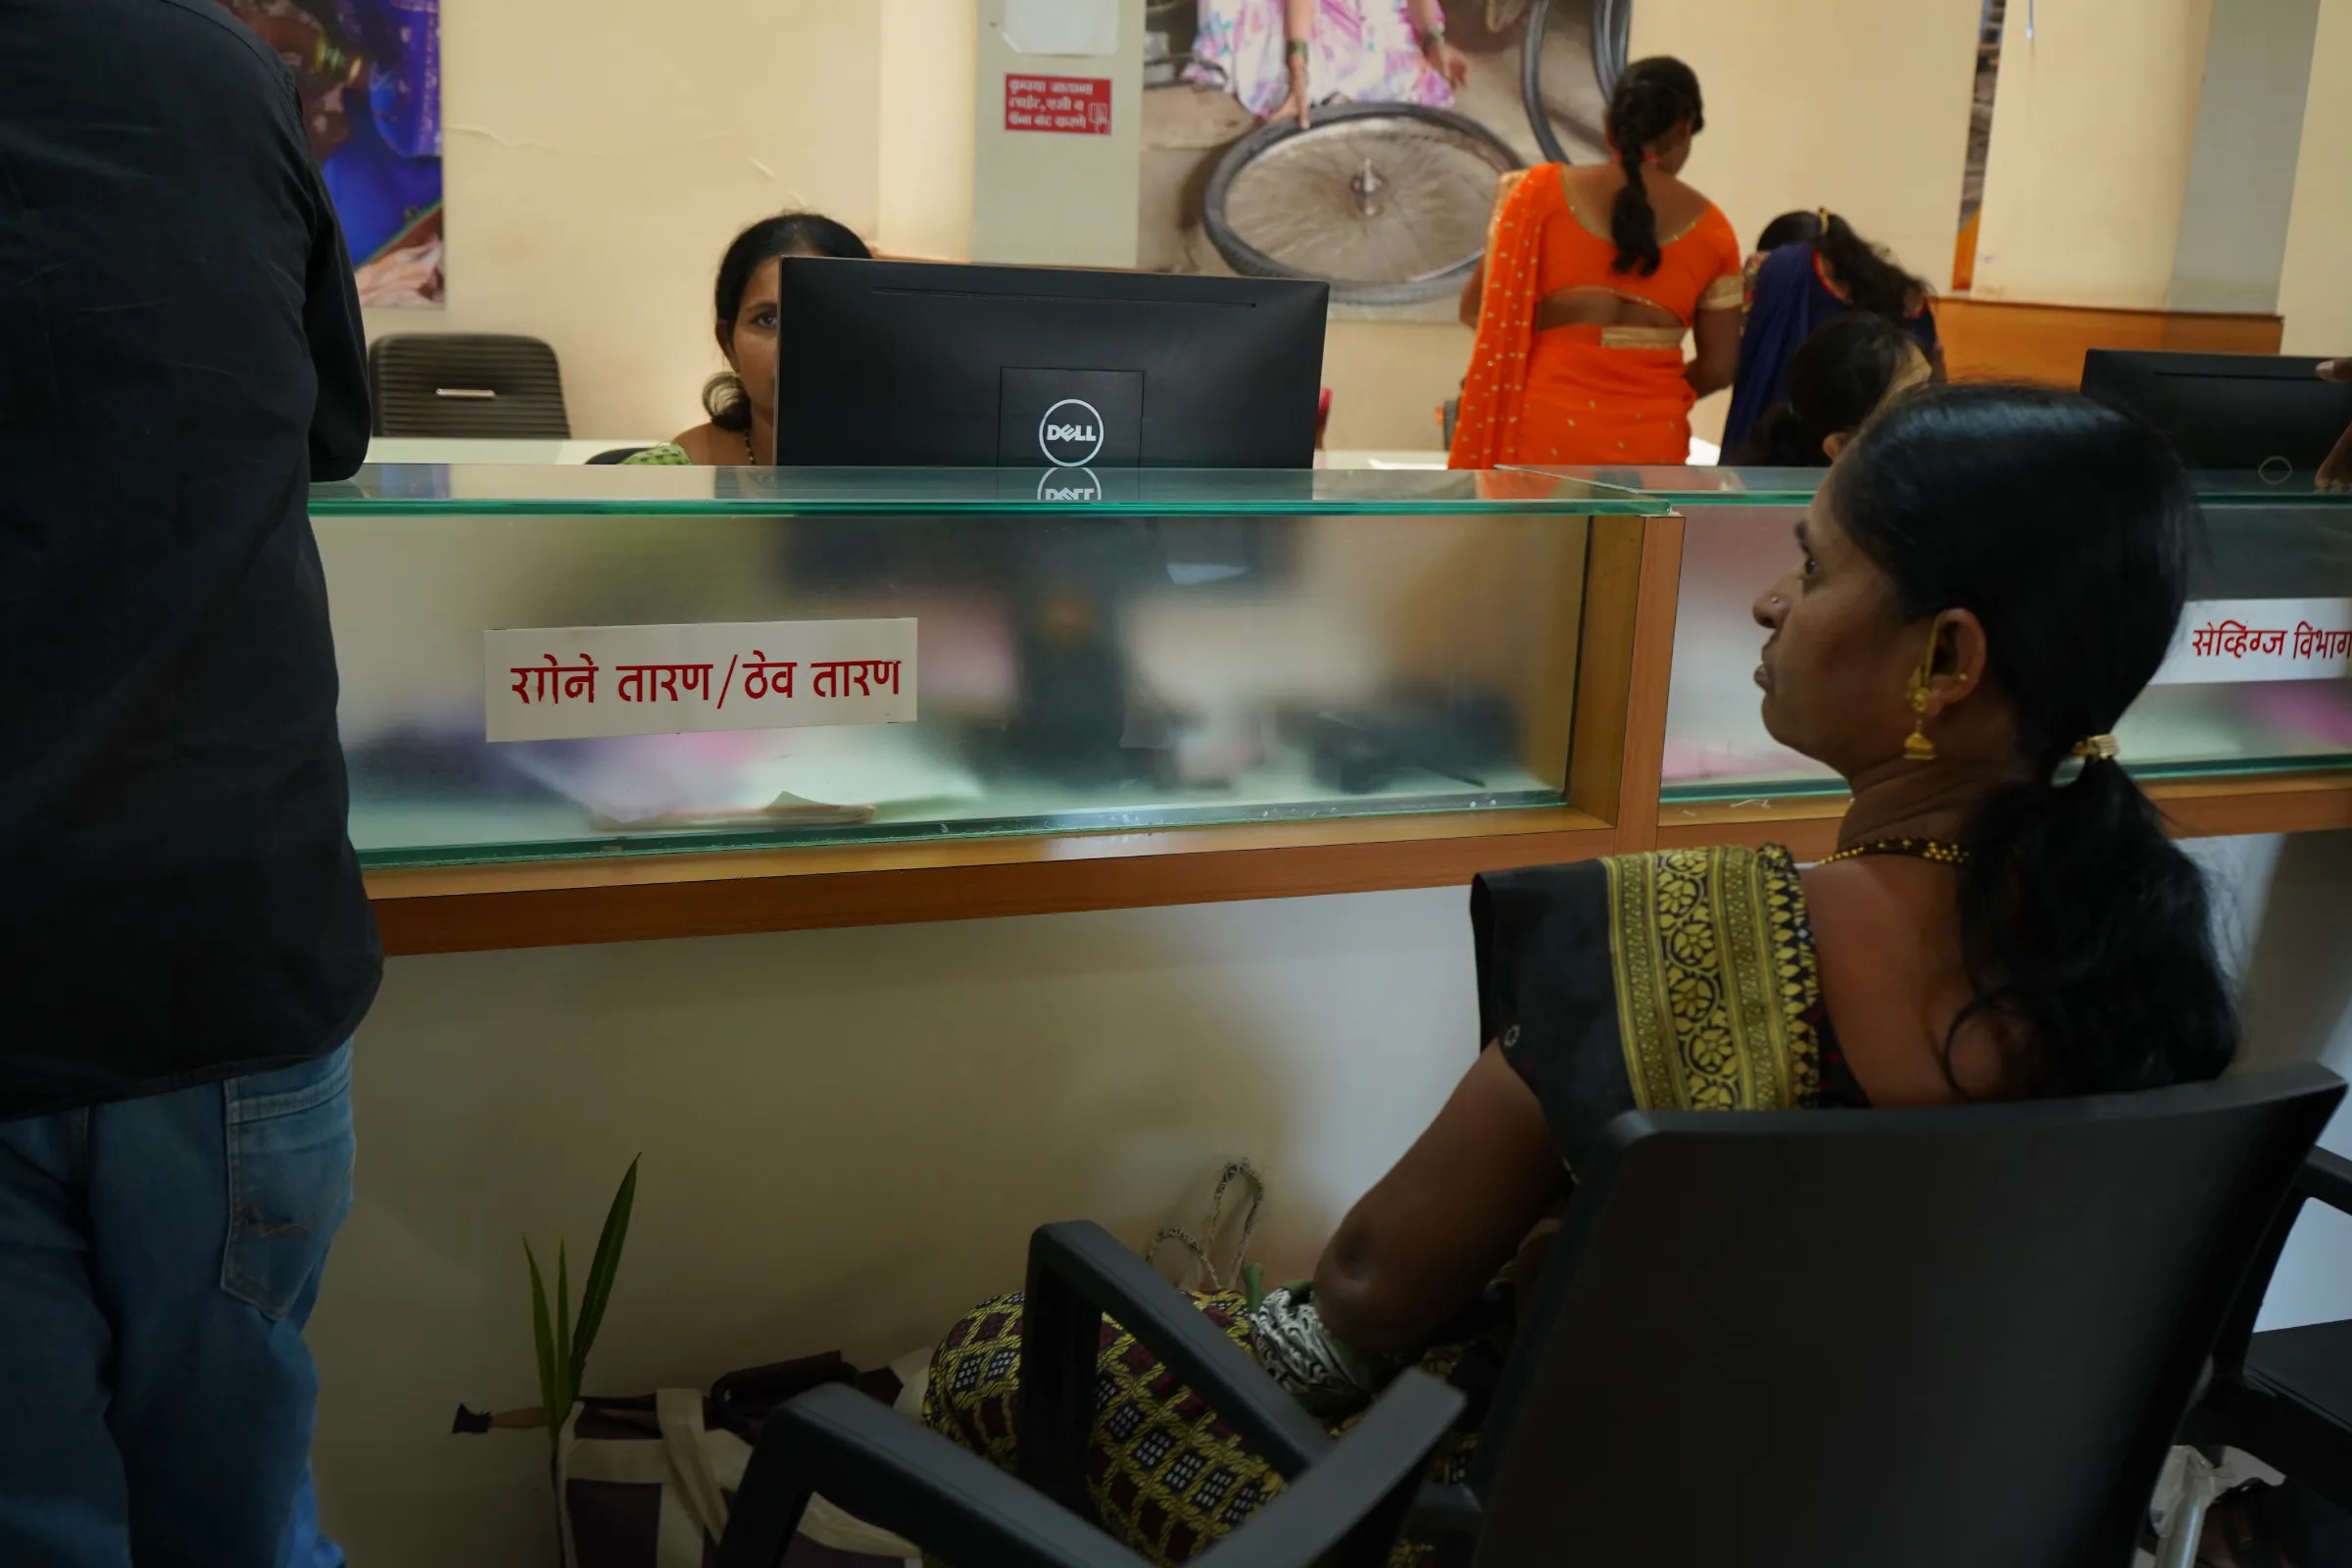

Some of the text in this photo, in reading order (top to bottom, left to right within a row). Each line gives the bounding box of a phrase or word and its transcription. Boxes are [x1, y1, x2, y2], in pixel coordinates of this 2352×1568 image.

[1047, 423, 1097, 442] DELL
[2292, 620, 2352, 660] विभाग
[809, 660, 902, 699] तारण
